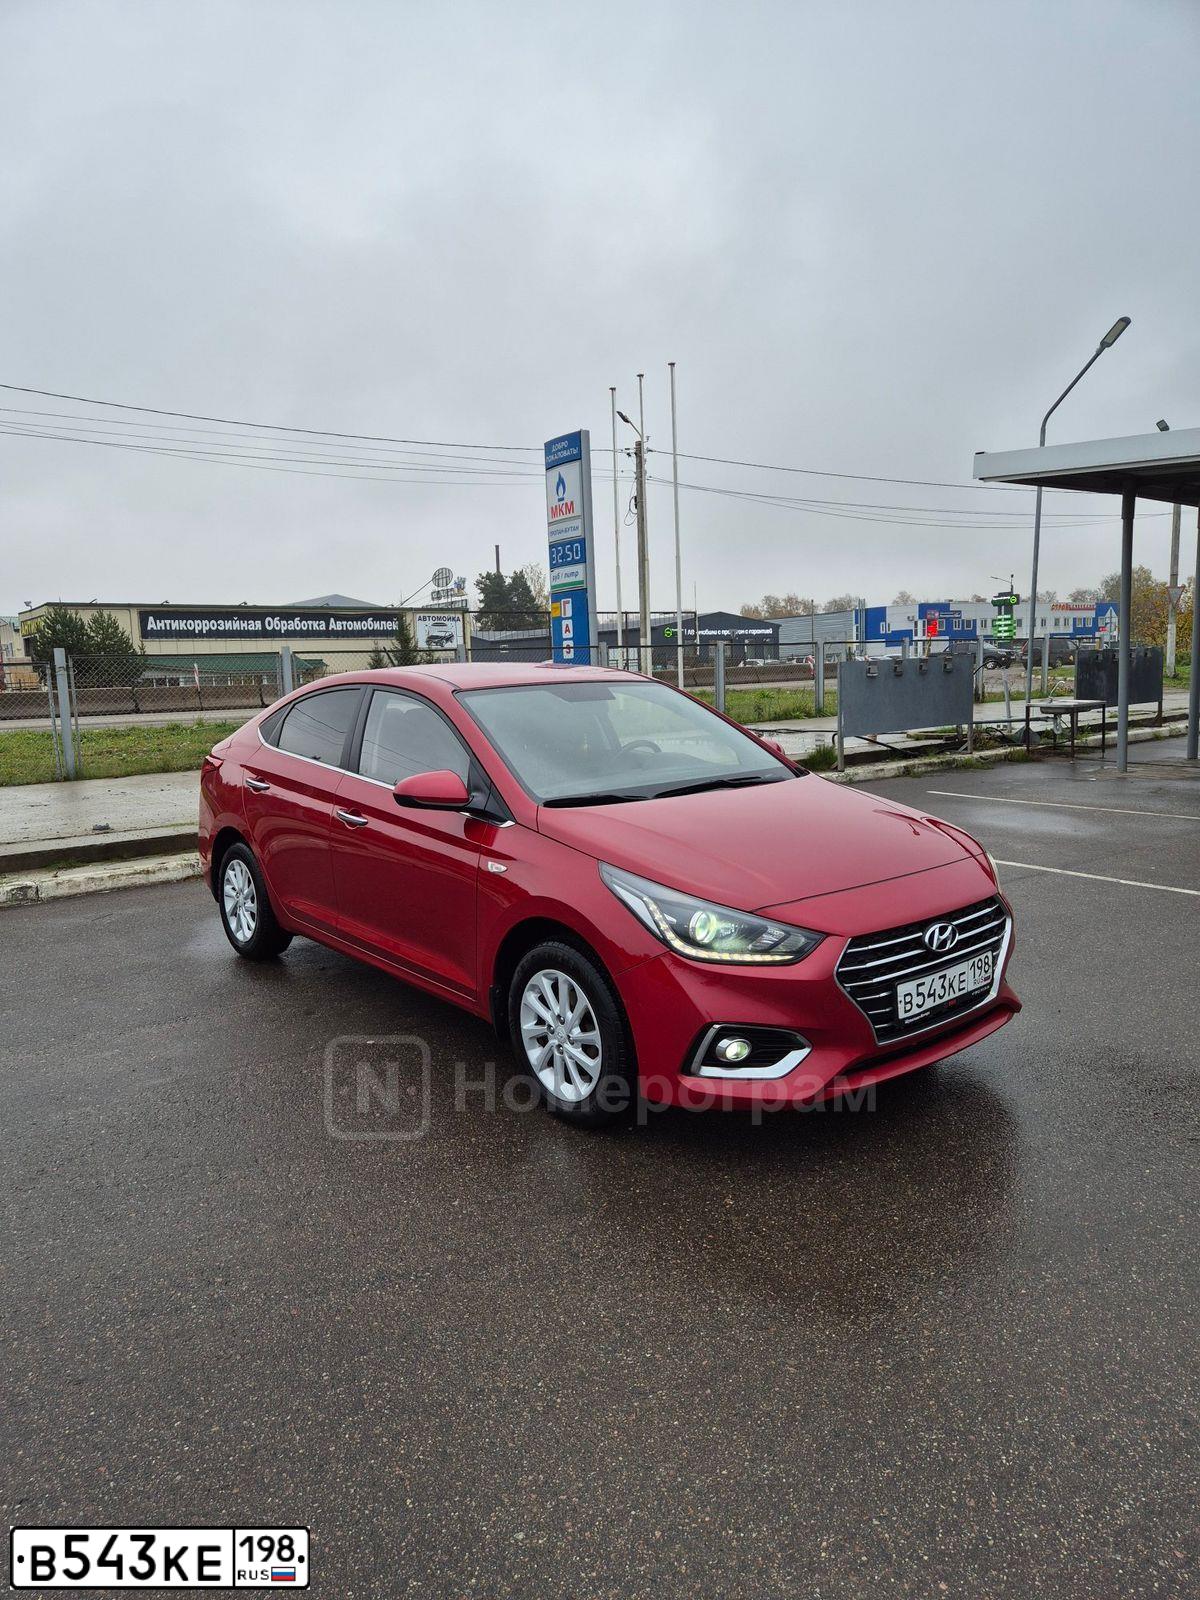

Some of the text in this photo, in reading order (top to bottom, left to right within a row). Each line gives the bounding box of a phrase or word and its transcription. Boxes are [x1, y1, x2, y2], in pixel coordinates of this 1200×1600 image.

[551, 440, 569, 453] ДОБРО
[550, 500, 575, 519] МКМ
[551, 543, 581, 564] 32.50
[147, 616, 399, 633] Антикоррозийная Обработка Автомобилей
[969, 955, 990, 979] 198
